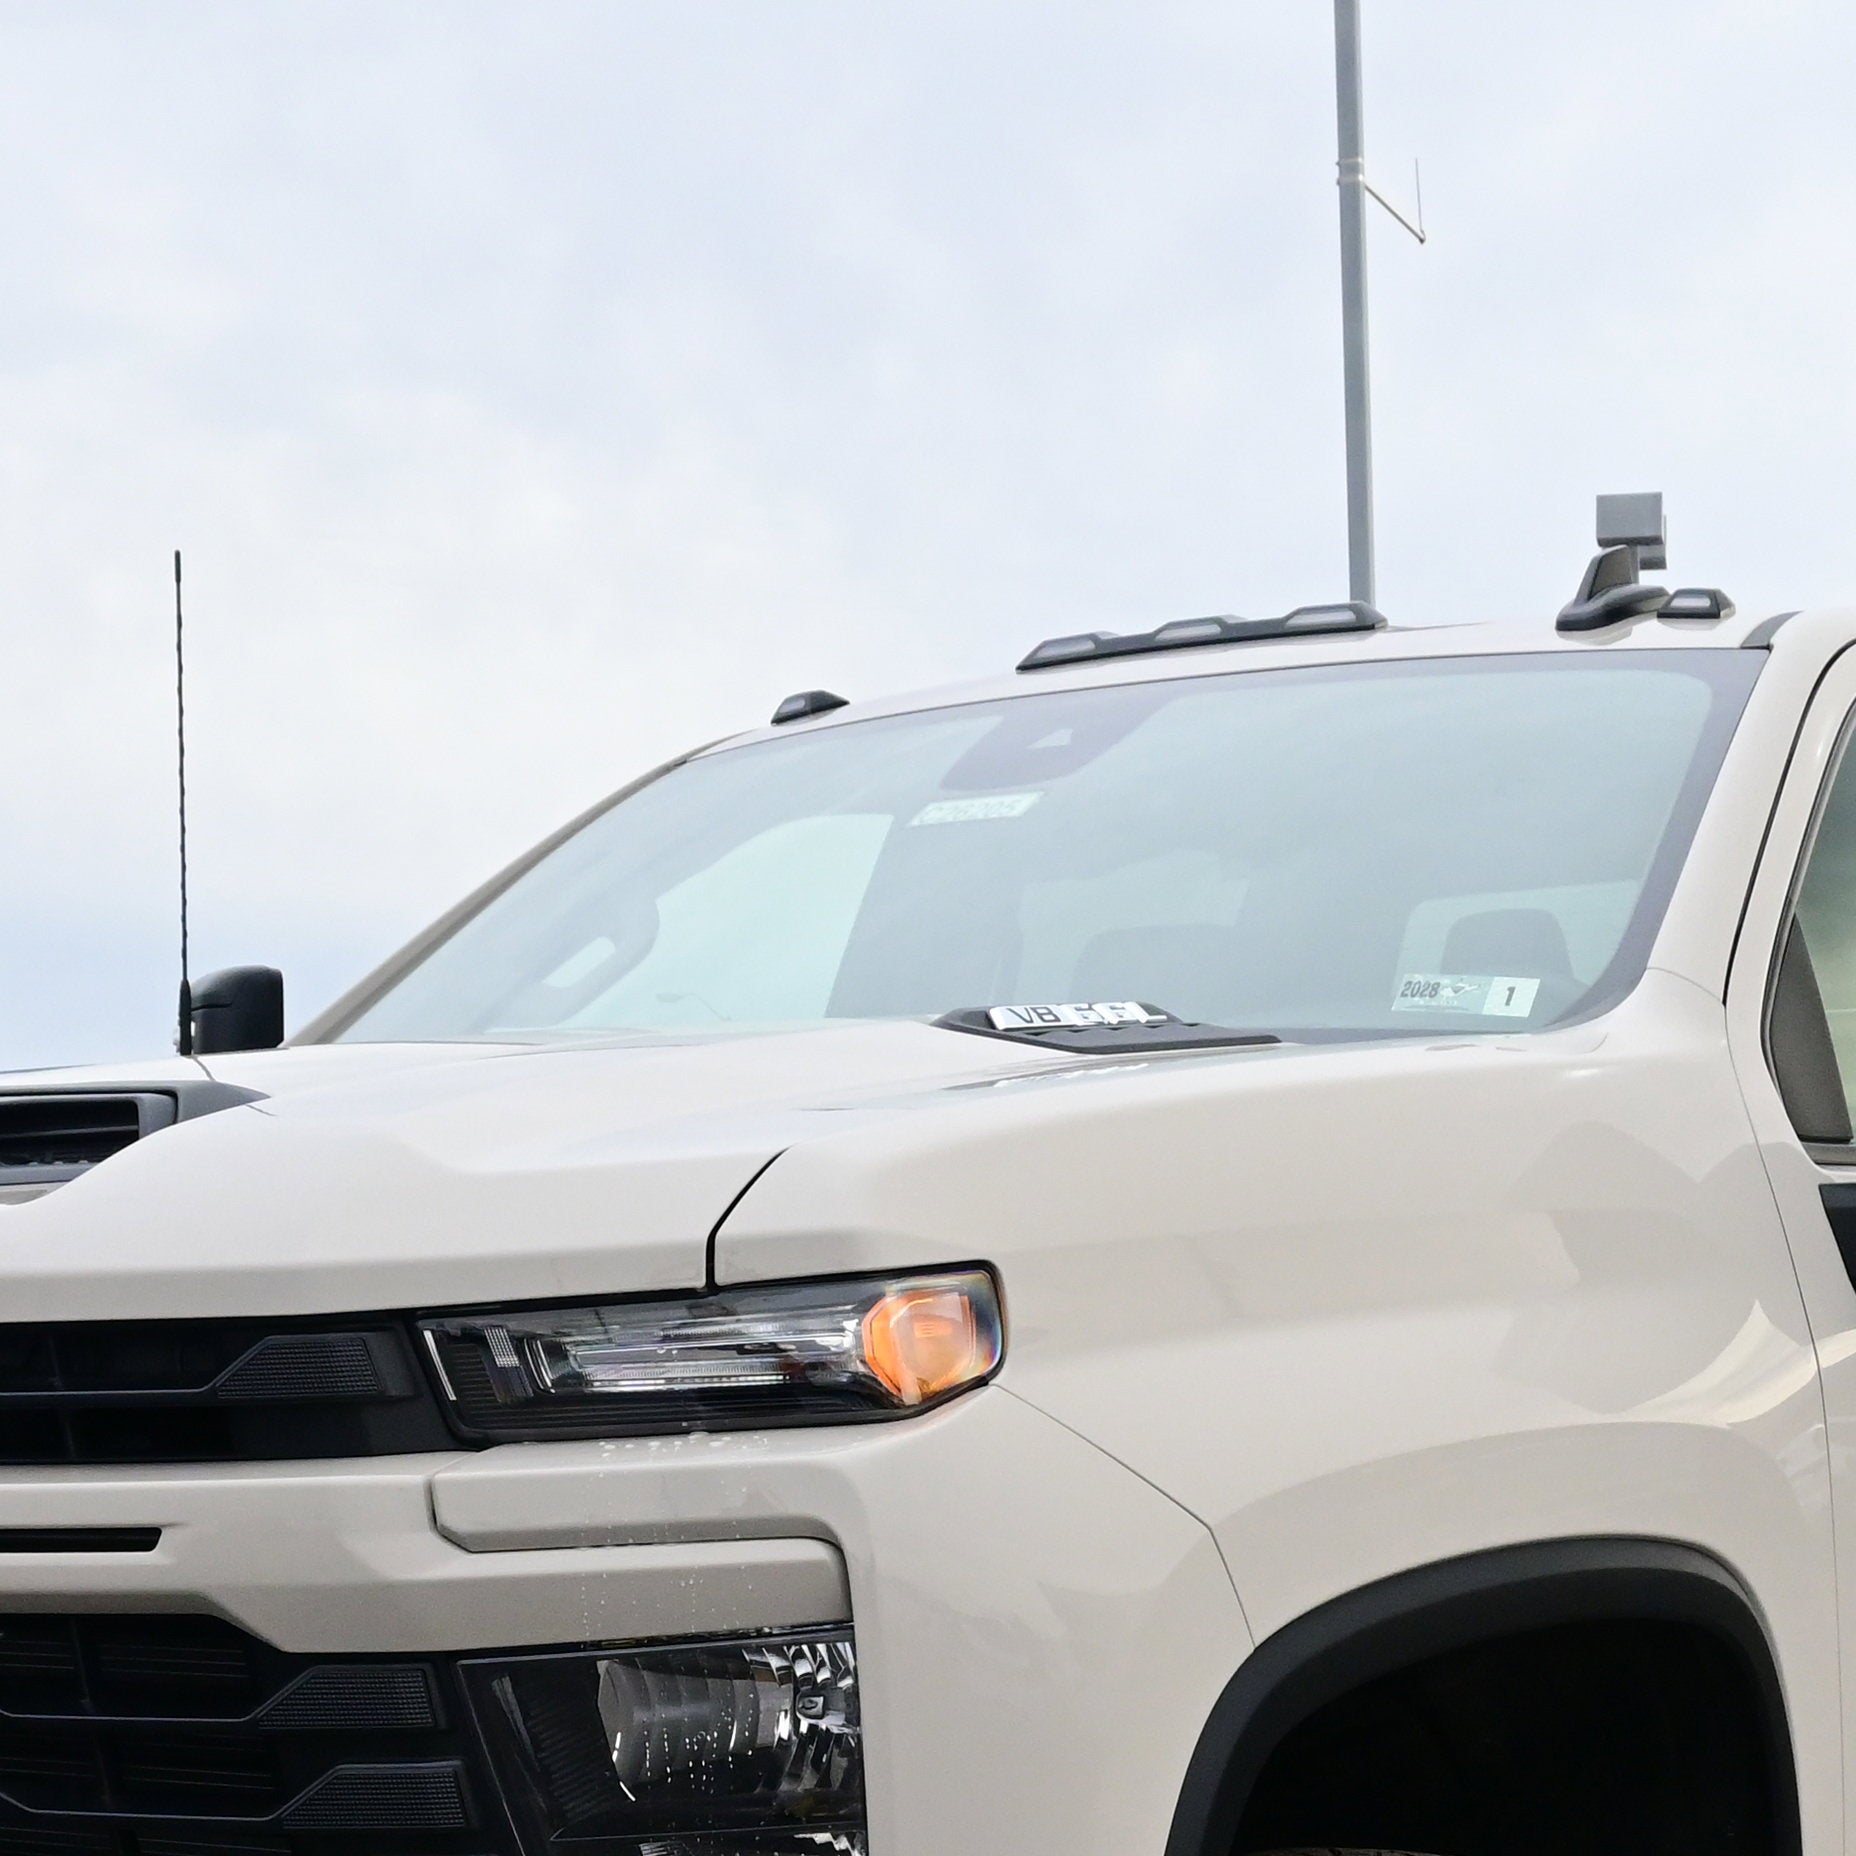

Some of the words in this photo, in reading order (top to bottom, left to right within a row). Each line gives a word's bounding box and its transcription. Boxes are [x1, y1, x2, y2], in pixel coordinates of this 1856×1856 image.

[1400, 980, 1441, 999] 2028
[1503, 986, 1516, 1007] 1
[1007, 1005, 1061, 1023] V8
